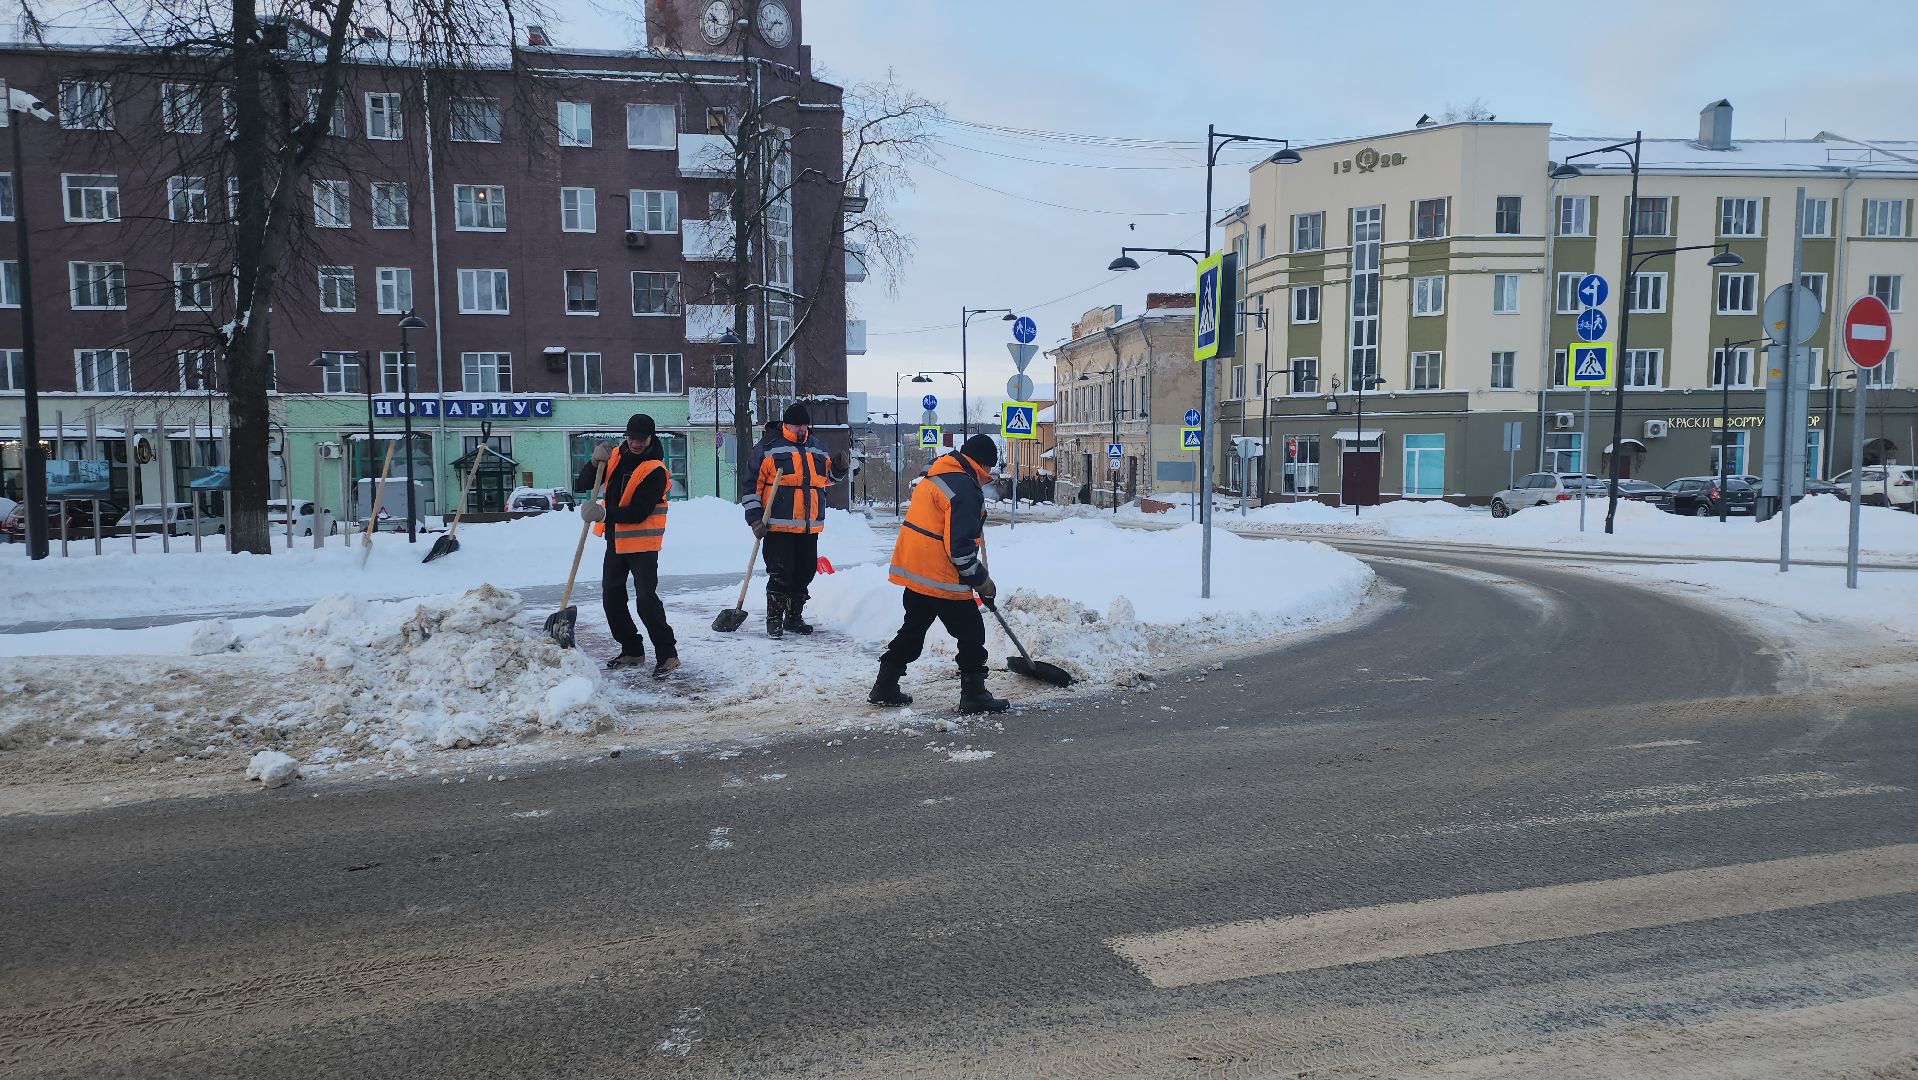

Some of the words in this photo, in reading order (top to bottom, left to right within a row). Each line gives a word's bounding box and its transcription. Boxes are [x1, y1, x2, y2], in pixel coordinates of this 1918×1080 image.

[1333, 160, 1352, 174] 19
[376, 402, 550, 415] НОТАРИУС
[1668, 417, 1710, 428] КРАСКИ
